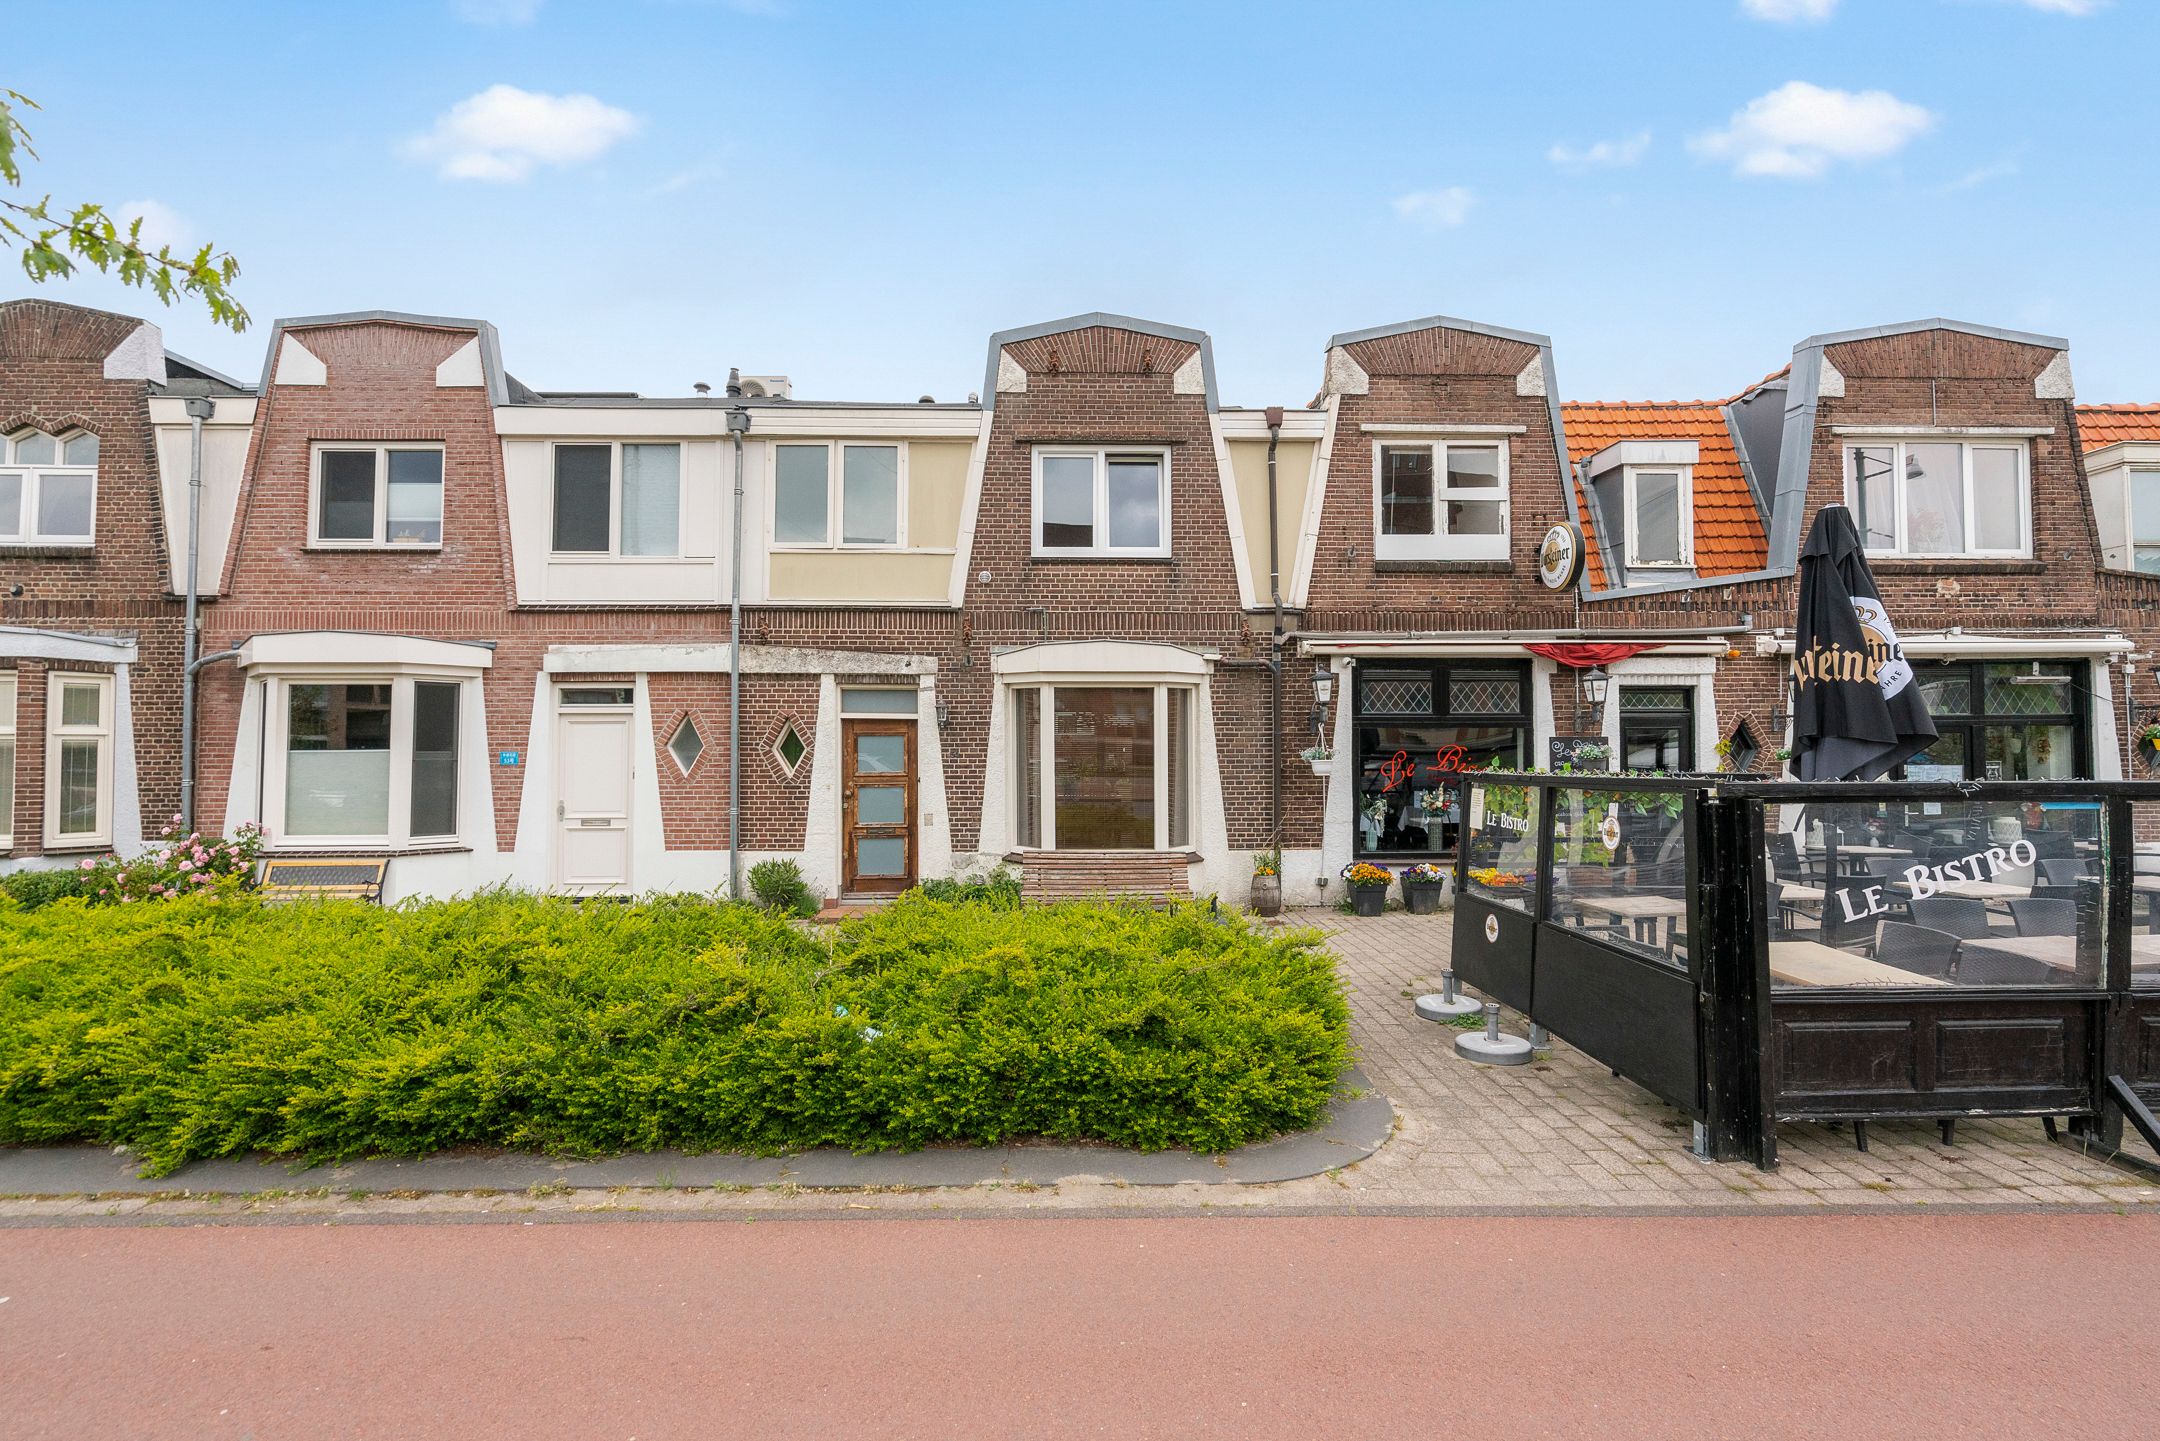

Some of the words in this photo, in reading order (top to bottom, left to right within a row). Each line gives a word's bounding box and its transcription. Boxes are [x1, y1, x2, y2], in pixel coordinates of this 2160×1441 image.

[1380, 750, 1416, 793] Le
[1486, 810, 1498, 827] LE
[1500, 812, 1529, 832] BISTRO
[1835, 884, 1890, 923] LE
[1902, 839, 2037, 900] BISTRO
